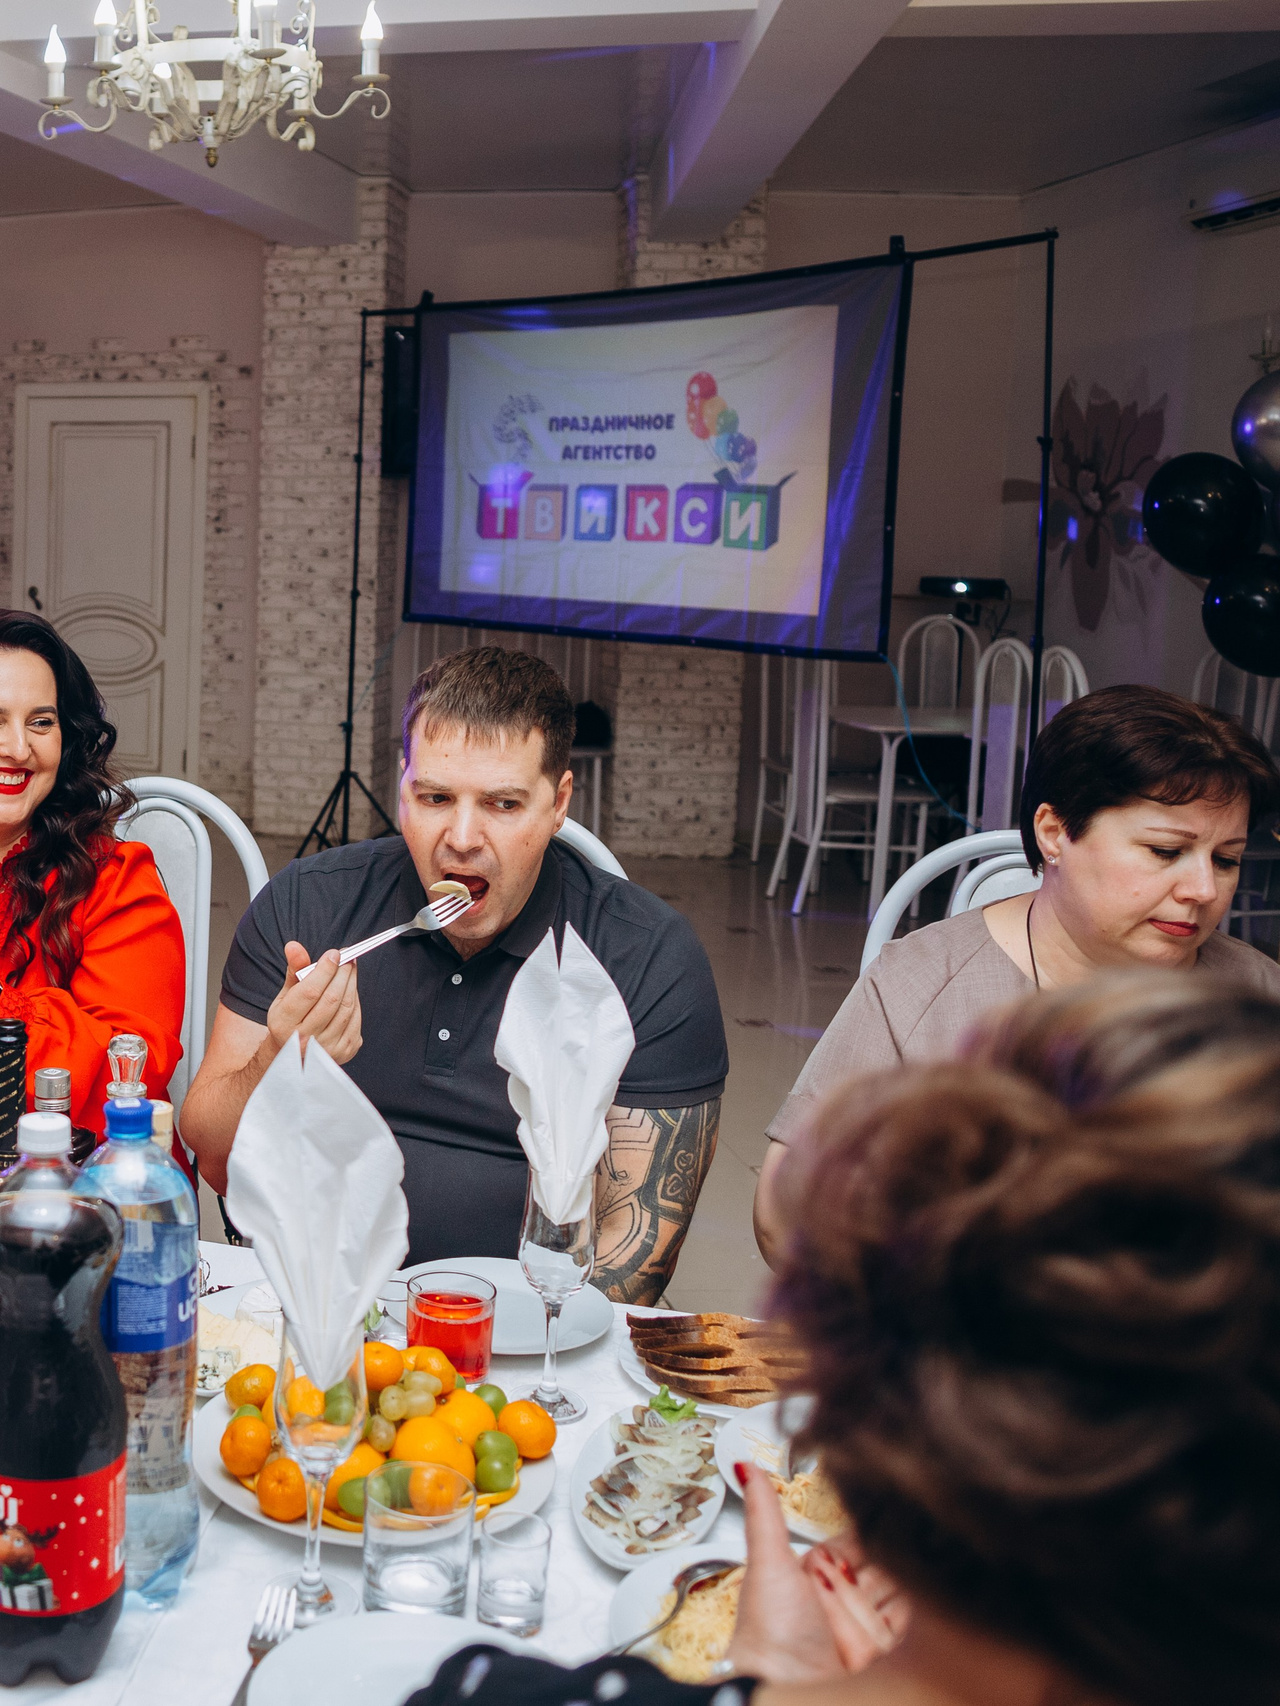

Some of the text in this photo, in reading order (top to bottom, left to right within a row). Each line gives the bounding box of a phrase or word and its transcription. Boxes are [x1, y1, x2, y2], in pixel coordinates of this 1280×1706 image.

[548, 413, 676, 434] ПРАЗДНИЧНОЕ
[561, 443, 657, 461] АГЕНТСТВО
[491, 494, 762, 543] ТВИКСИ
